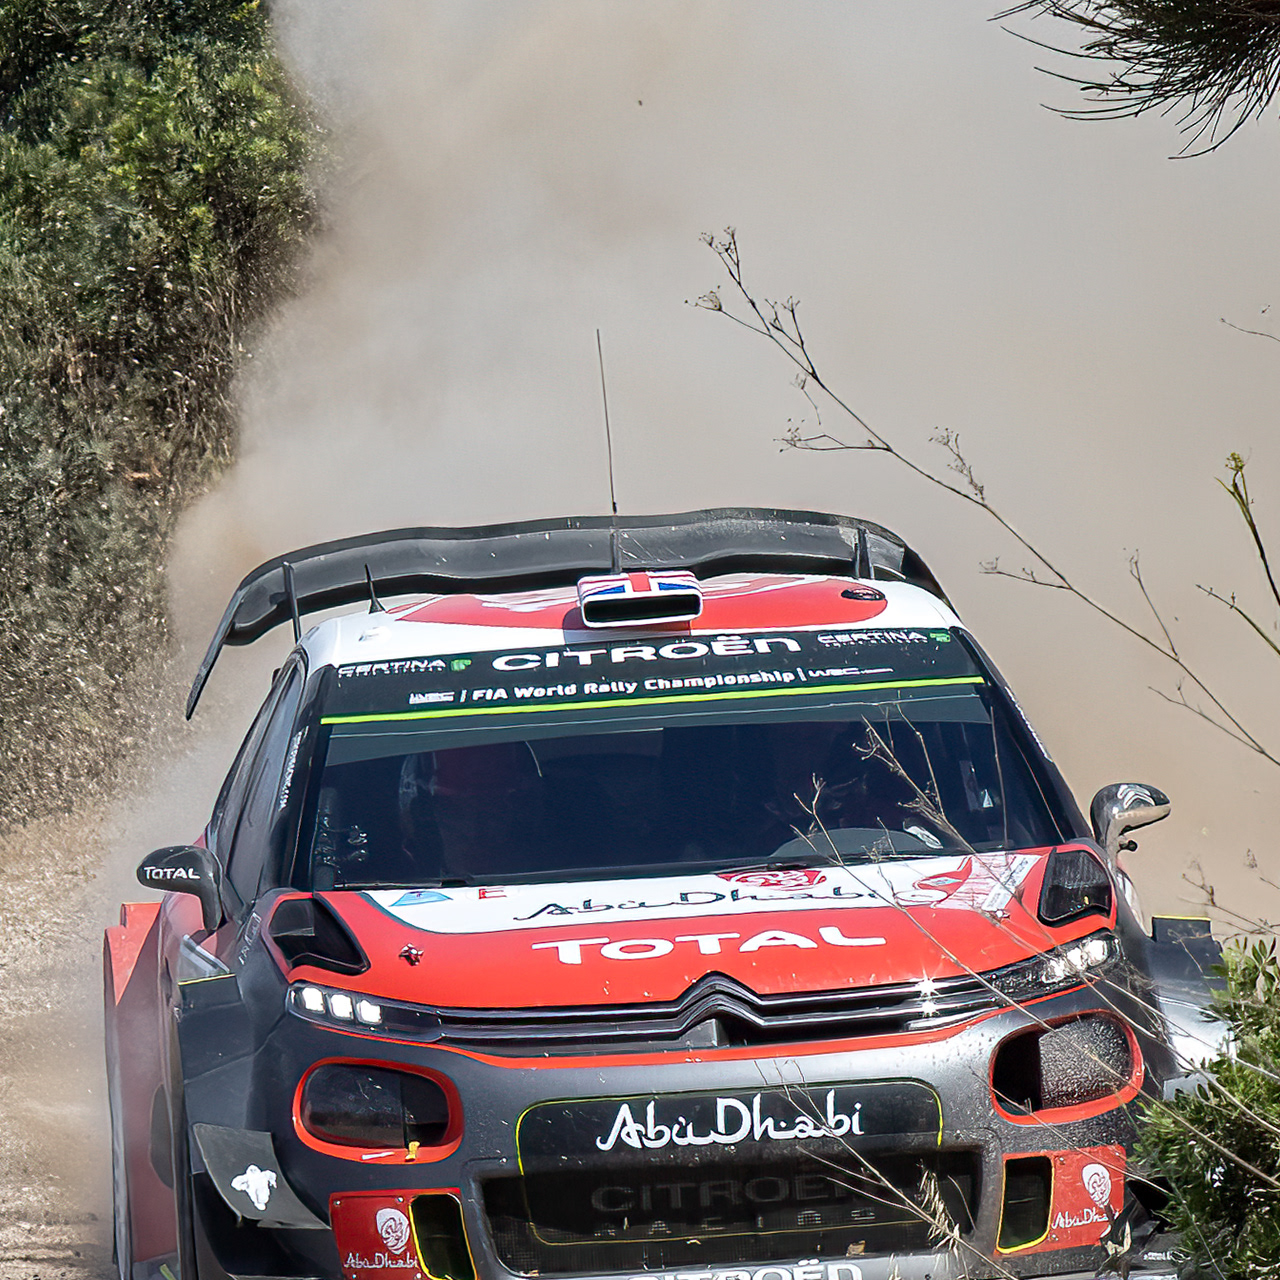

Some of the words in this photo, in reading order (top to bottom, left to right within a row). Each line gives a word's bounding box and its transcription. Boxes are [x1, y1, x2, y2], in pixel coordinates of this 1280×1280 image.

[817, 631, 928, 644] CERTINA
[472, 688, 508, 700] FIA
[514, 683, 577, 699] World
[584, 680, 638, 694] Rally
[644, 668, 796, 690] Championship
[143, 866, 201, 879] TOTAL
[532, 926, 887, 965] TOTAL
[595, 1100, 712, 1151] Abu
[714, 1089, 865, 1144] Dhabi
[343, 1252, 371, 1269] Abu
[374, 1251, 417, 1269] Dhabi
